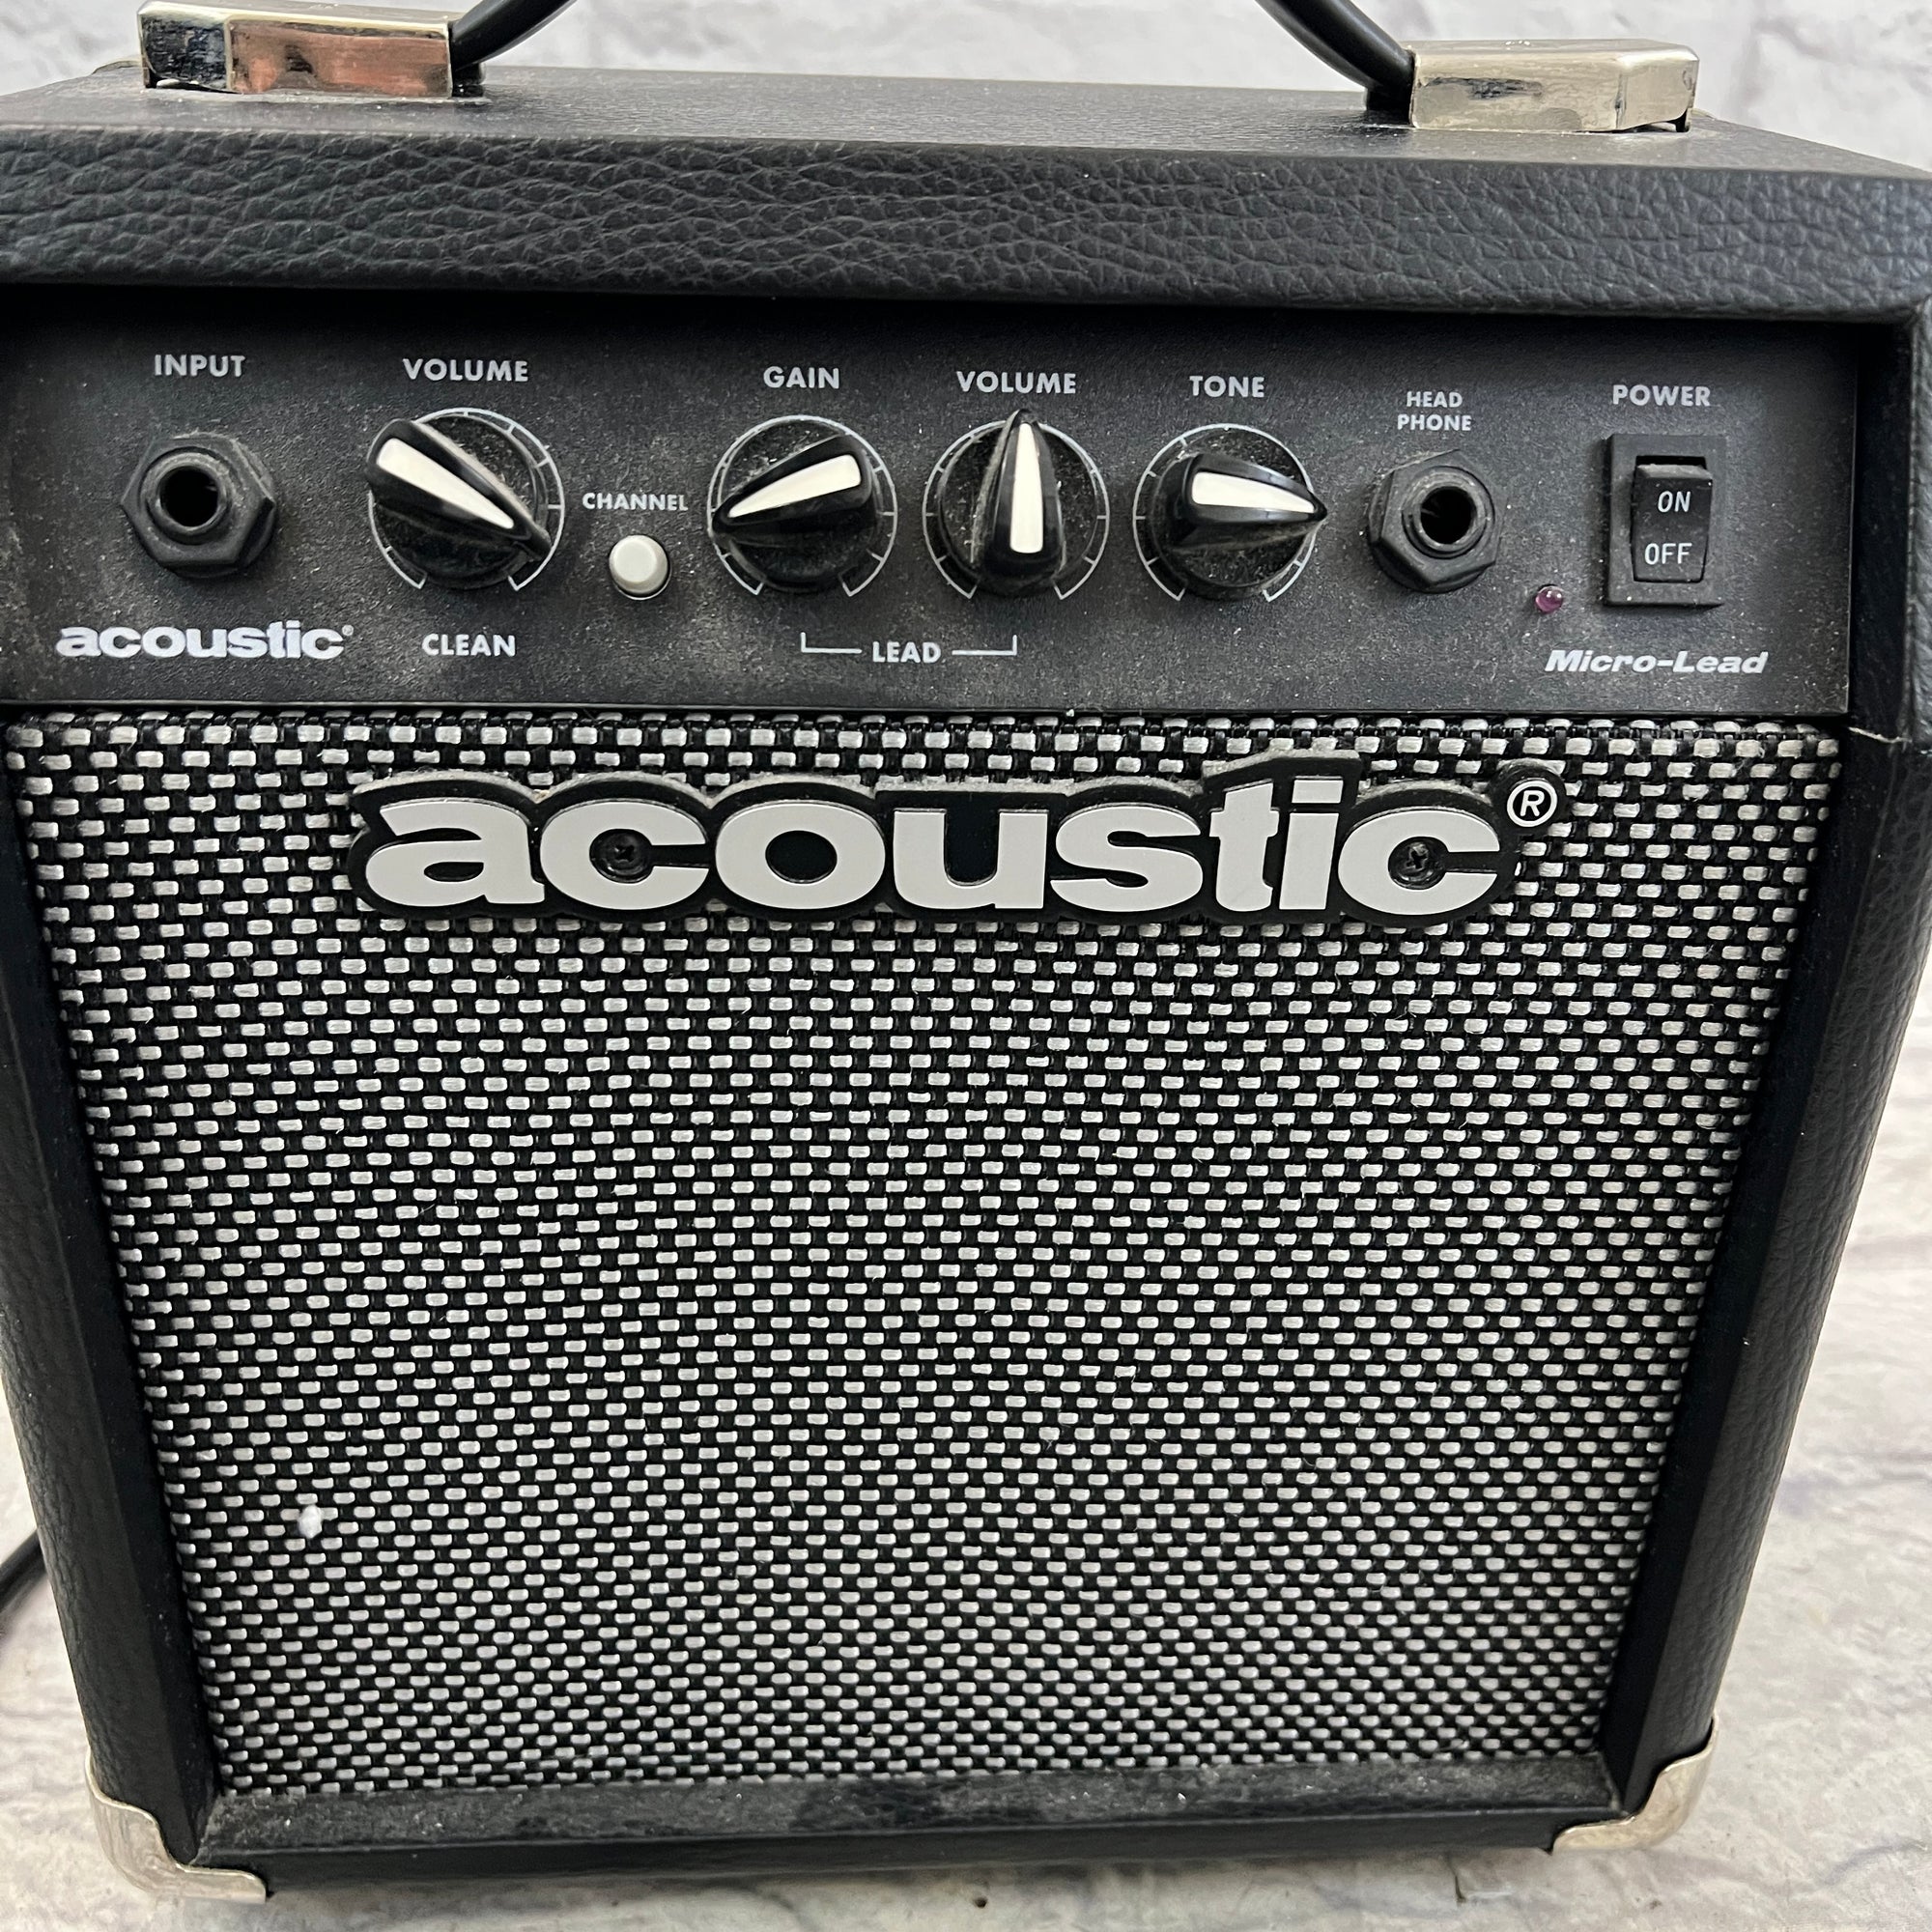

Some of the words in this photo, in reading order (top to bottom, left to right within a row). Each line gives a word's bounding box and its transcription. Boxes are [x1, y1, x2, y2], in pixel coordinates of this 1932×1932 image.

[154, 354, 245, 378] INPUT
[403, 358, 528, 383] VOLUME
[763, 366, 839, 389] GAIN
[956, 371, 1076, 394] VOLUME
[1190, 376, 1264, 398] TONE
[1406, 391, 1463, 409] HEAD
[1612, 384, 1711, 408] POWER
[1397, 414, 1471, 431] PHONE
[582, 492, 688, 512] CHANNEL
[1658, 491, 1690, 512] ON
[1644, 543, 1692, 564] OFF
[422, 634, 515, 657] CLEAN
[872, 641, 941, 664] LEAD
[1545, 649, 1770, 675] Micro-Lead
